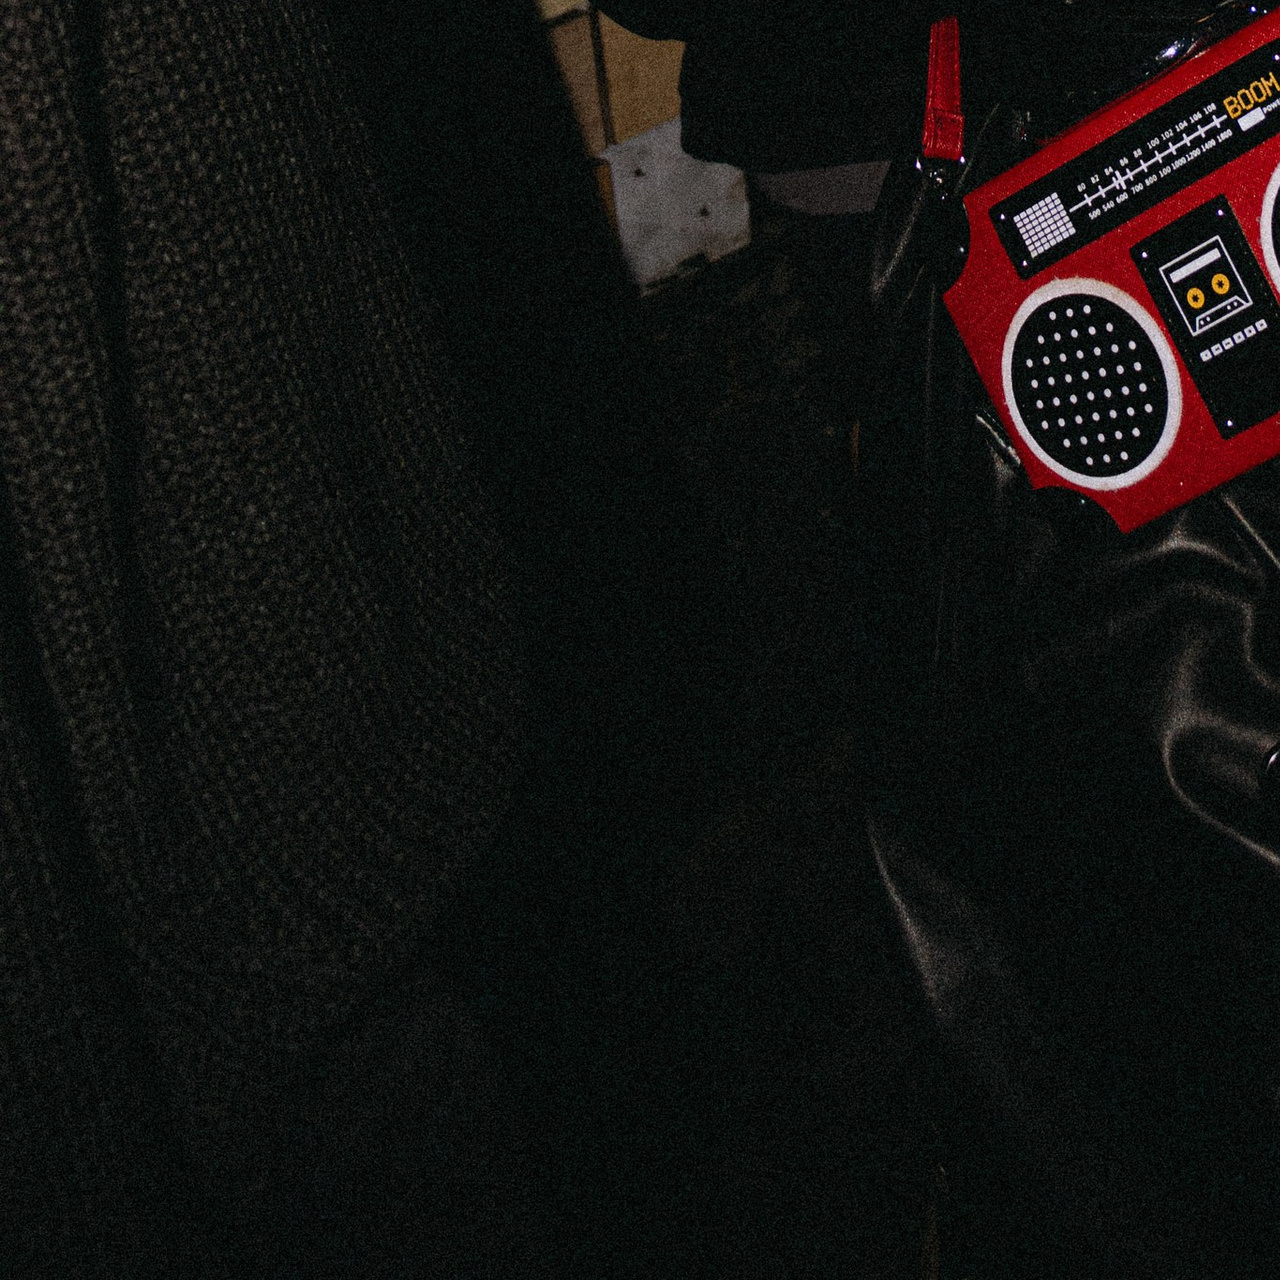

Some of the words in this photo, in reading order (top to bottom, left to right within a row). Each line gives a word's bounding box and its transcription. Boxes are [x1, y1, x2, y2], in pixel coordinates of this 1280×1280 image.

[1077, 182, 1086, 192] 80
[1090, 174, 1100, 184] 82
[1104, 166, 1114, 176] 84
[1119, 156, 1129, 167] 86
[1132, 148, 1142, 158] 88
[1146, 137, 1160, 149] 100
[1161, 128, 1174, 141] 102
[1174, 120, 1188, 133] 104
[1189, 111, 1202, 124] 106
[1203, 102, 1217, 115] 108
[1088, 208, 1101, 220] 500
[1115, 191, 1129, 204] 600
[1130, 182, 1144, 195] 700
[1144, 174, 1158, 187] 800
[1158, 165, 1172, 178] 100
[1185, 147, 1201, 162] 1200
[1200, 138, 1216, 152] 1400
